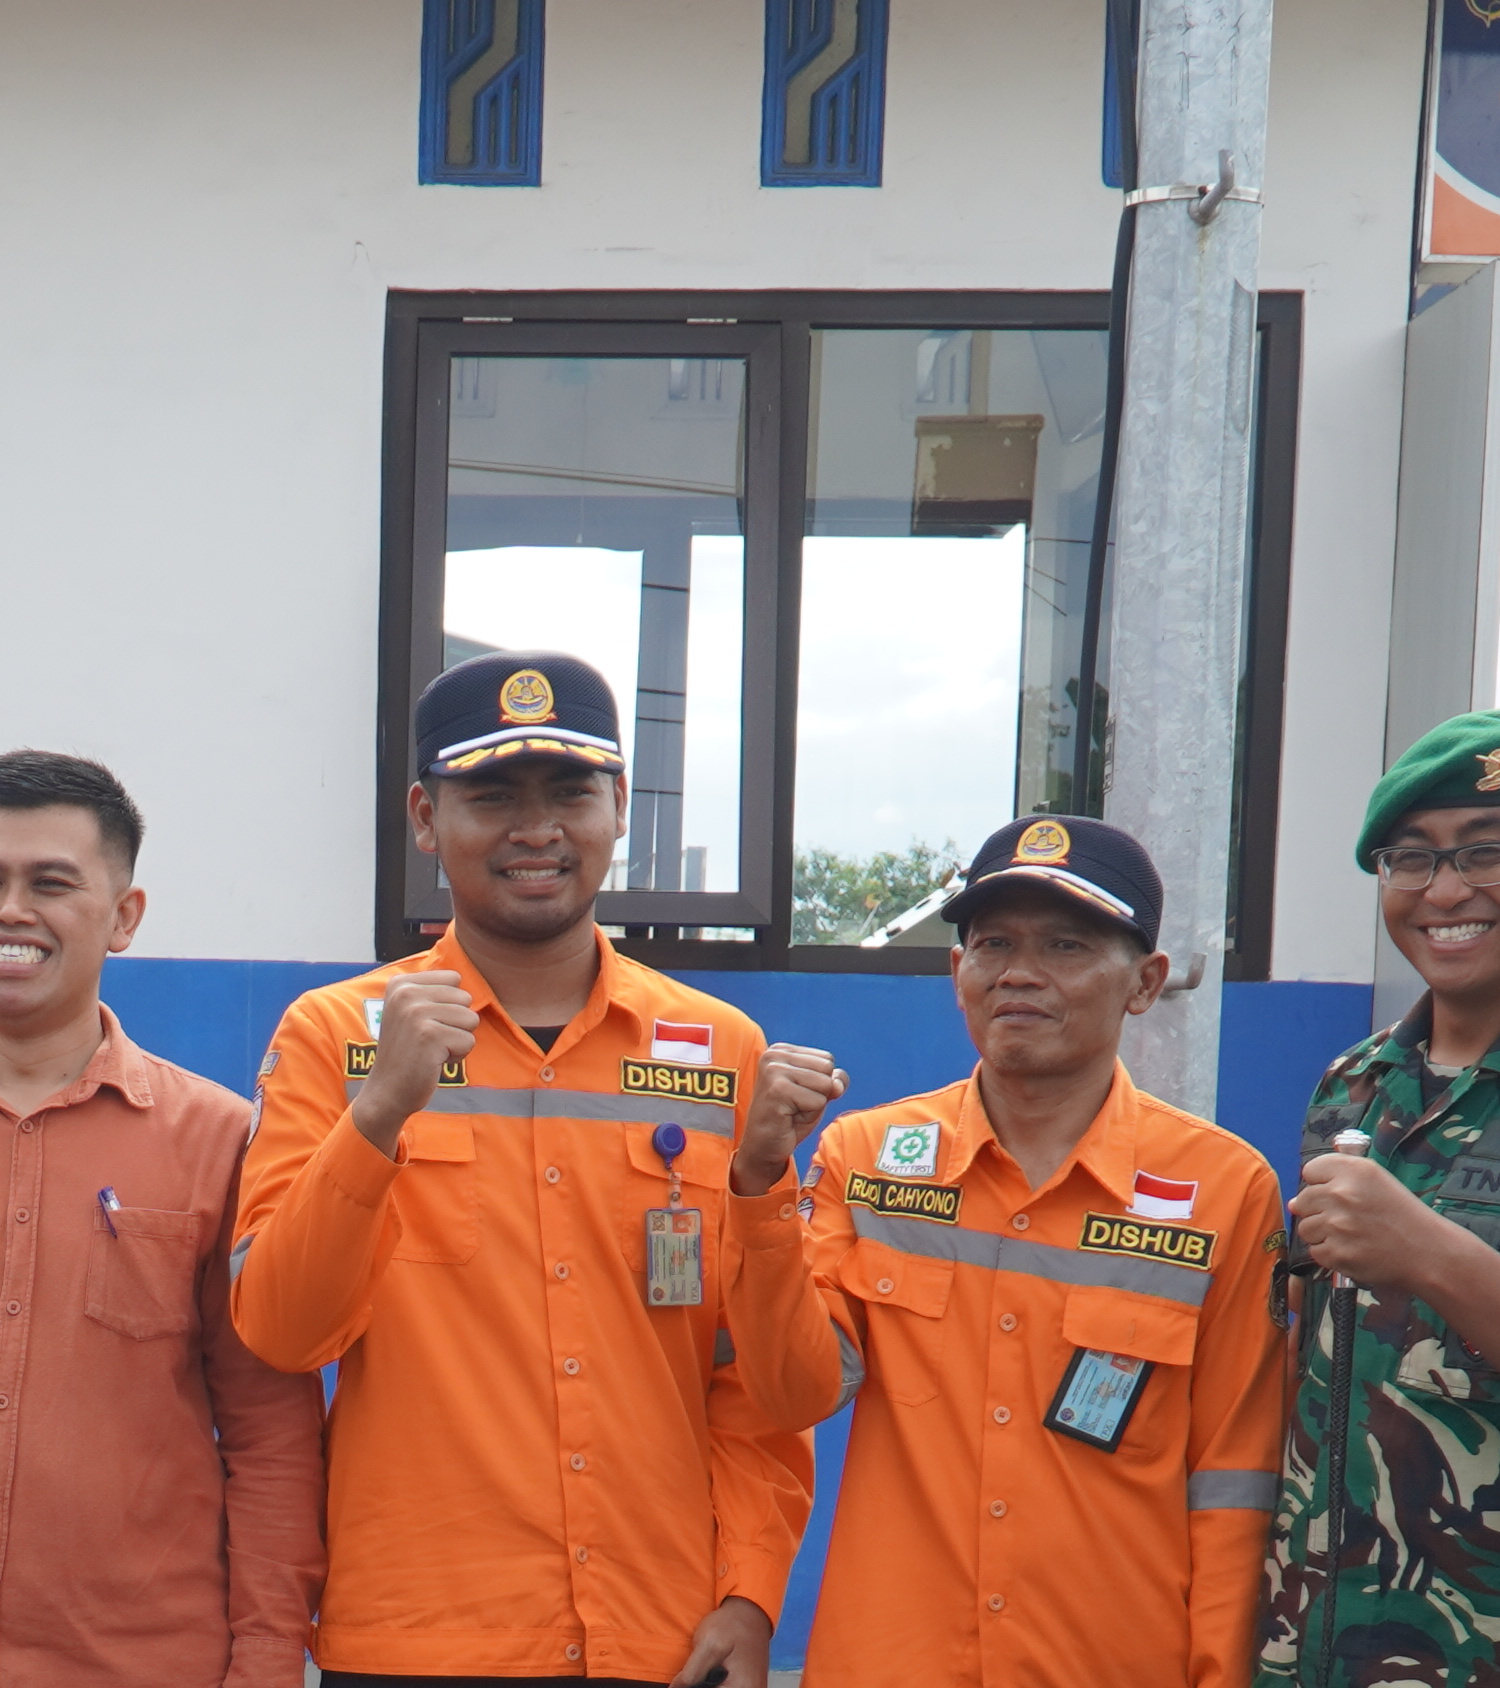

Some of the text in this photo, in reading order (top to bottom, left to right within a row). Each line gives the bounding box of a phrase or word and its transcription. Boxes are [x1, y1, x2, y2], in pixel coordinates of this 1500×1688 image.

[626, 1064, 731, 1098] DISHUB
[850, 1178, 956, 1215] RUDI CAHYONO
[1088, 1219, 1207, 1261] DISHUB
